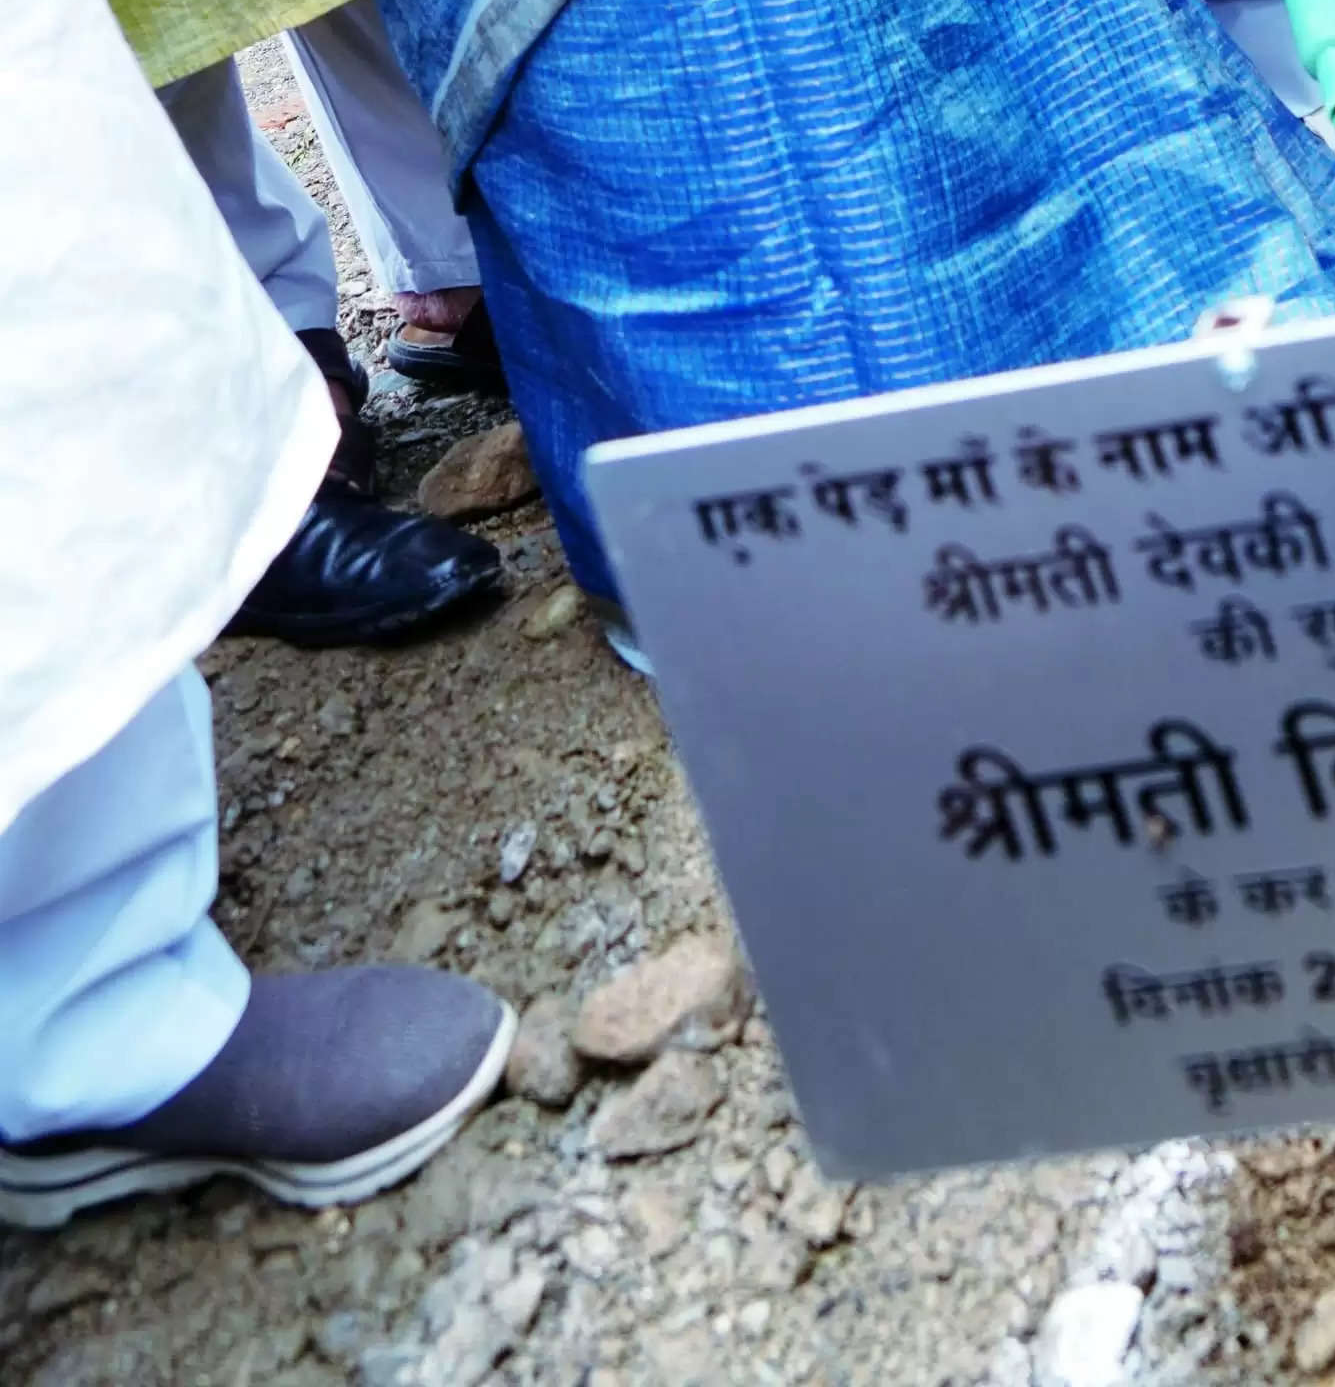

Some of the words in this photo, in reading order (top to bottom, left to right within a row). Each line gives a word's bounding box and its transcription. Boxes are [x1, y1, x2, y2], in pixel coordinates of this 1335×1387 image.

[1012, 426, 1082, 493] के
[1092, 413, 1225, 483] नाम
[922, 524, 1124, 625] श्रीमती
[1135, 489, 1332, 593] देवकी
[1190, 594, 1278, 665] की
[936, 717, 1252, 863] श्रीमती
[1232, 863, 1334, 917] कर
